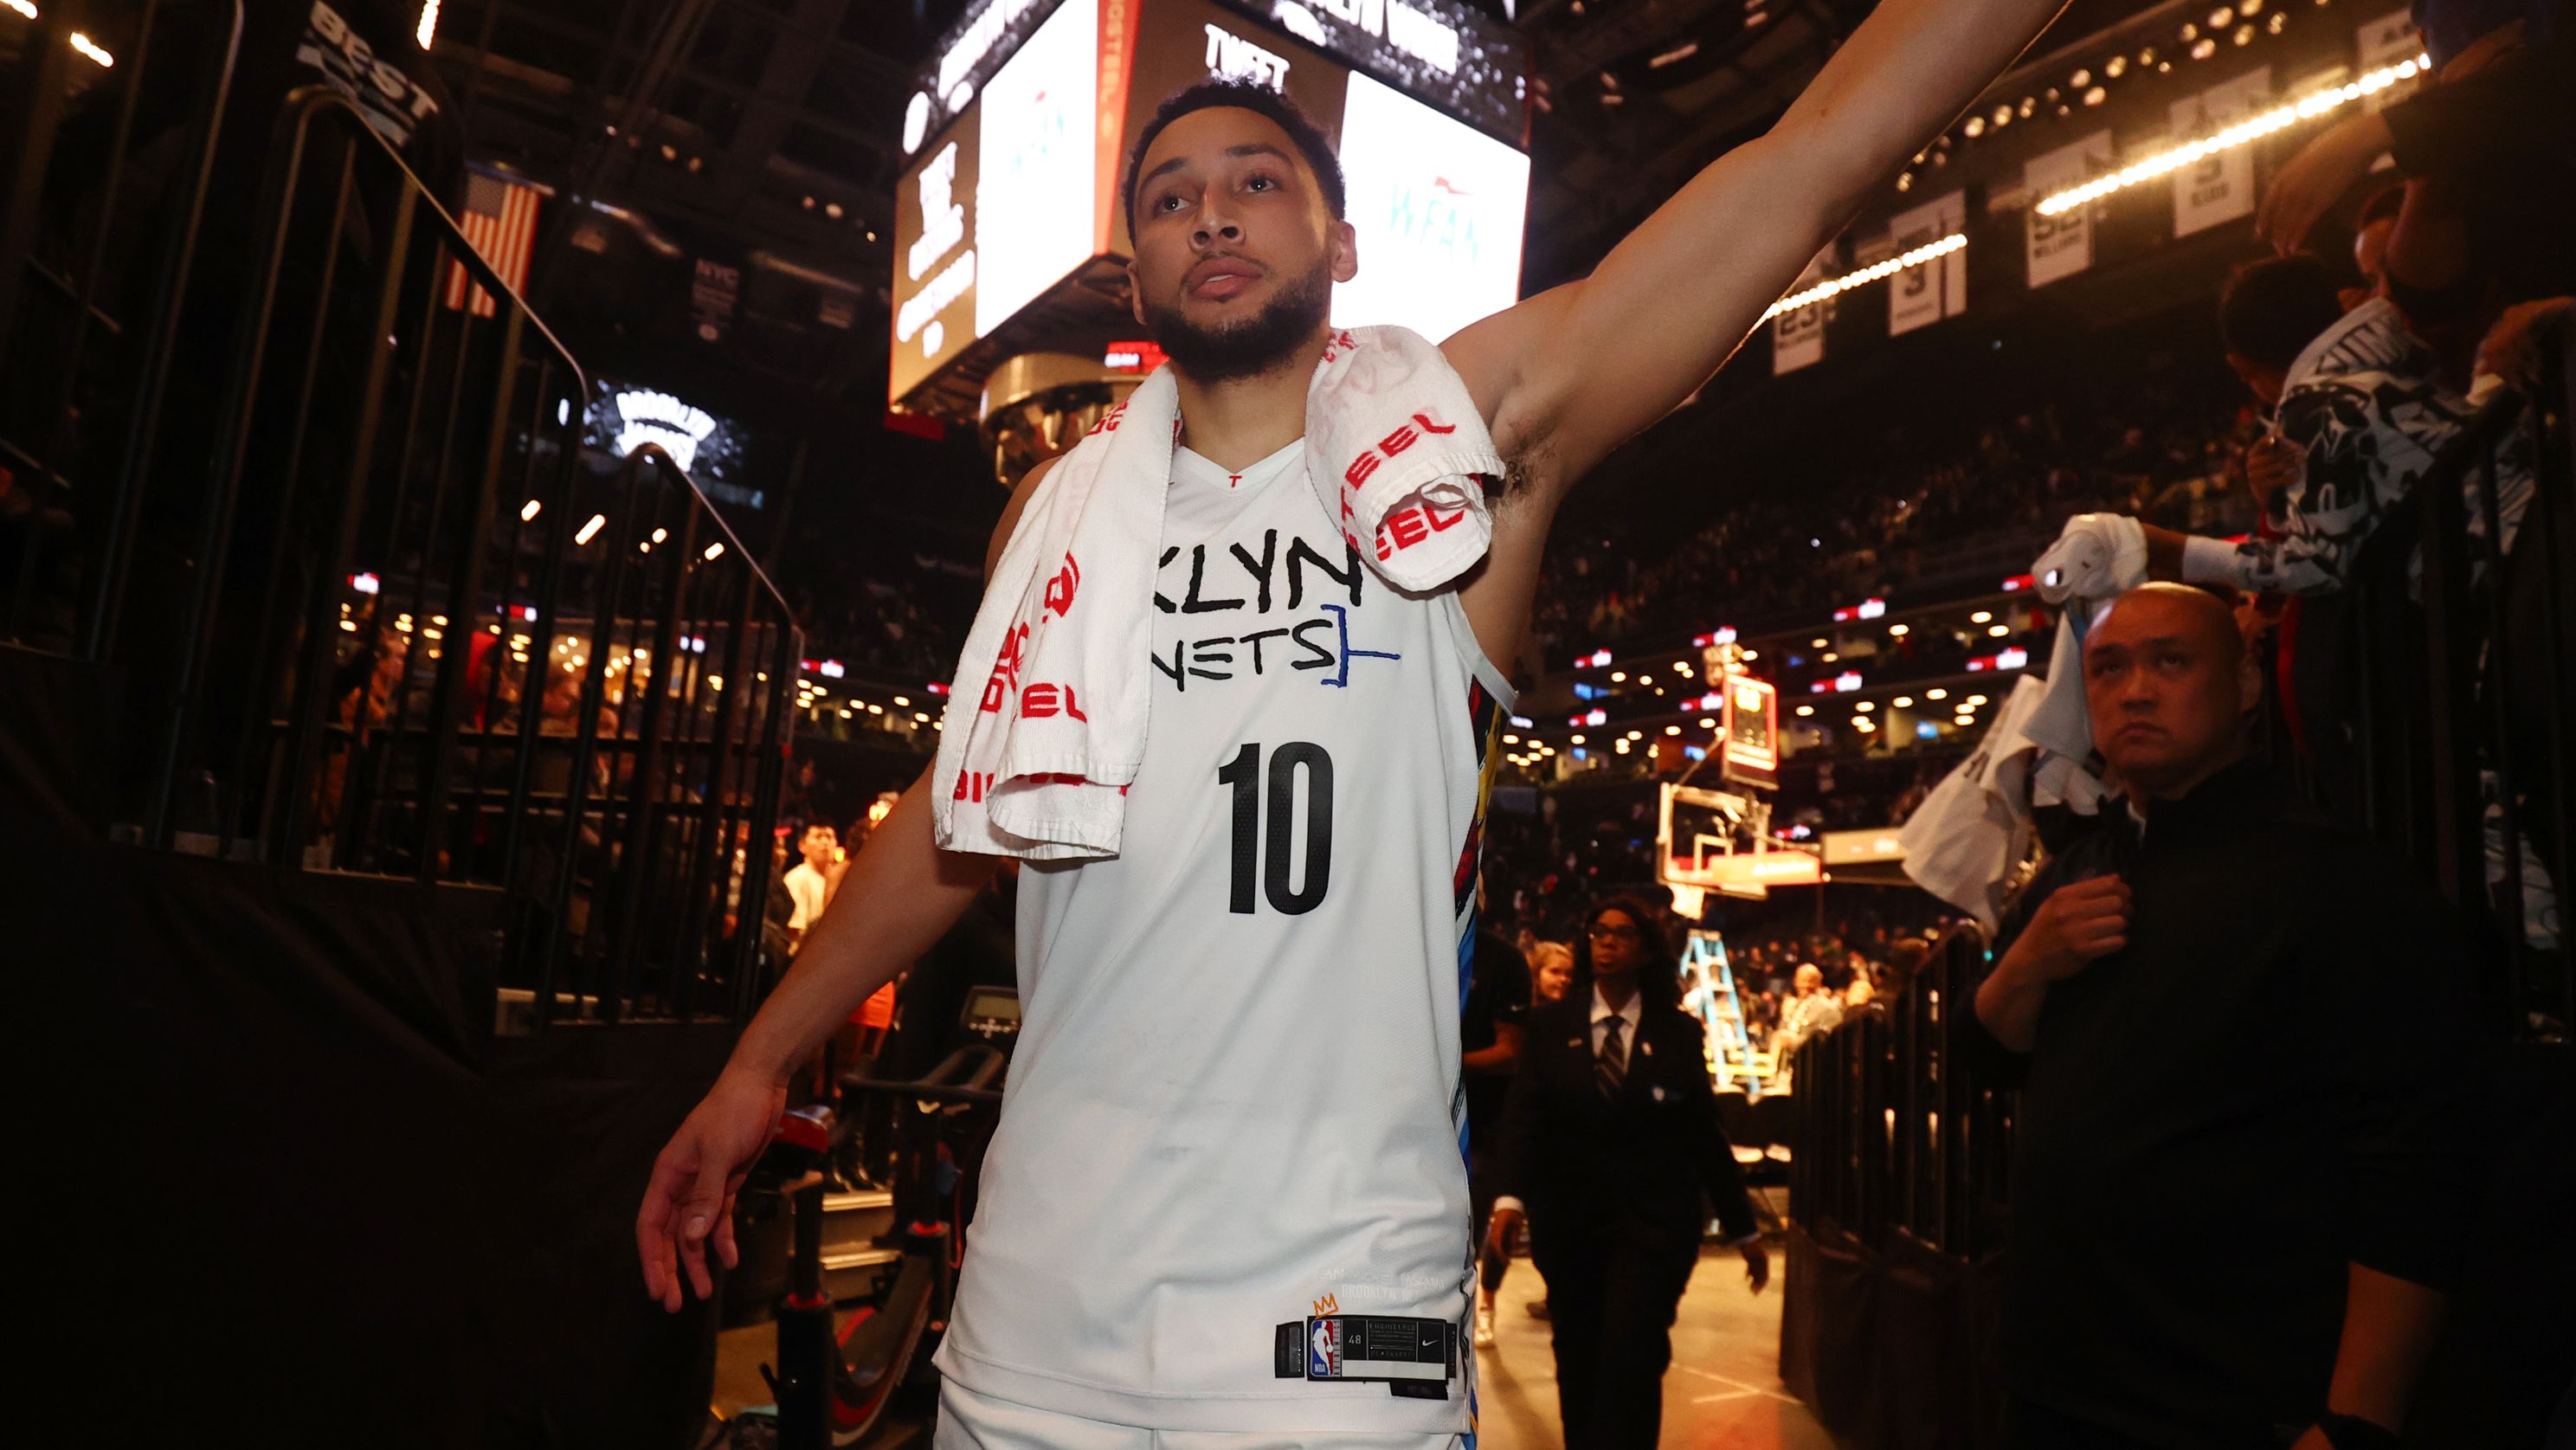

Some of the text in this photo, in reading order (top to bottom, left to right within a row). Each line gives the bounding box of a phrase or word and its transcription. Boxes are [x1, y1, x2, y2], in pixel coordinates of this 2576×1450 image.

[309, 0, 441, 119] BEST
[1099, 0, 1124, 103] OSTEEL
[1204, 23, 1291, 94] TWEET
[1229, 475, 1242, 487] T
[1219, 741, 1334, 915] 10
[1314, 1363, 1326, 1373] NBA
[1349, 1334, 1362, 1344] 48
